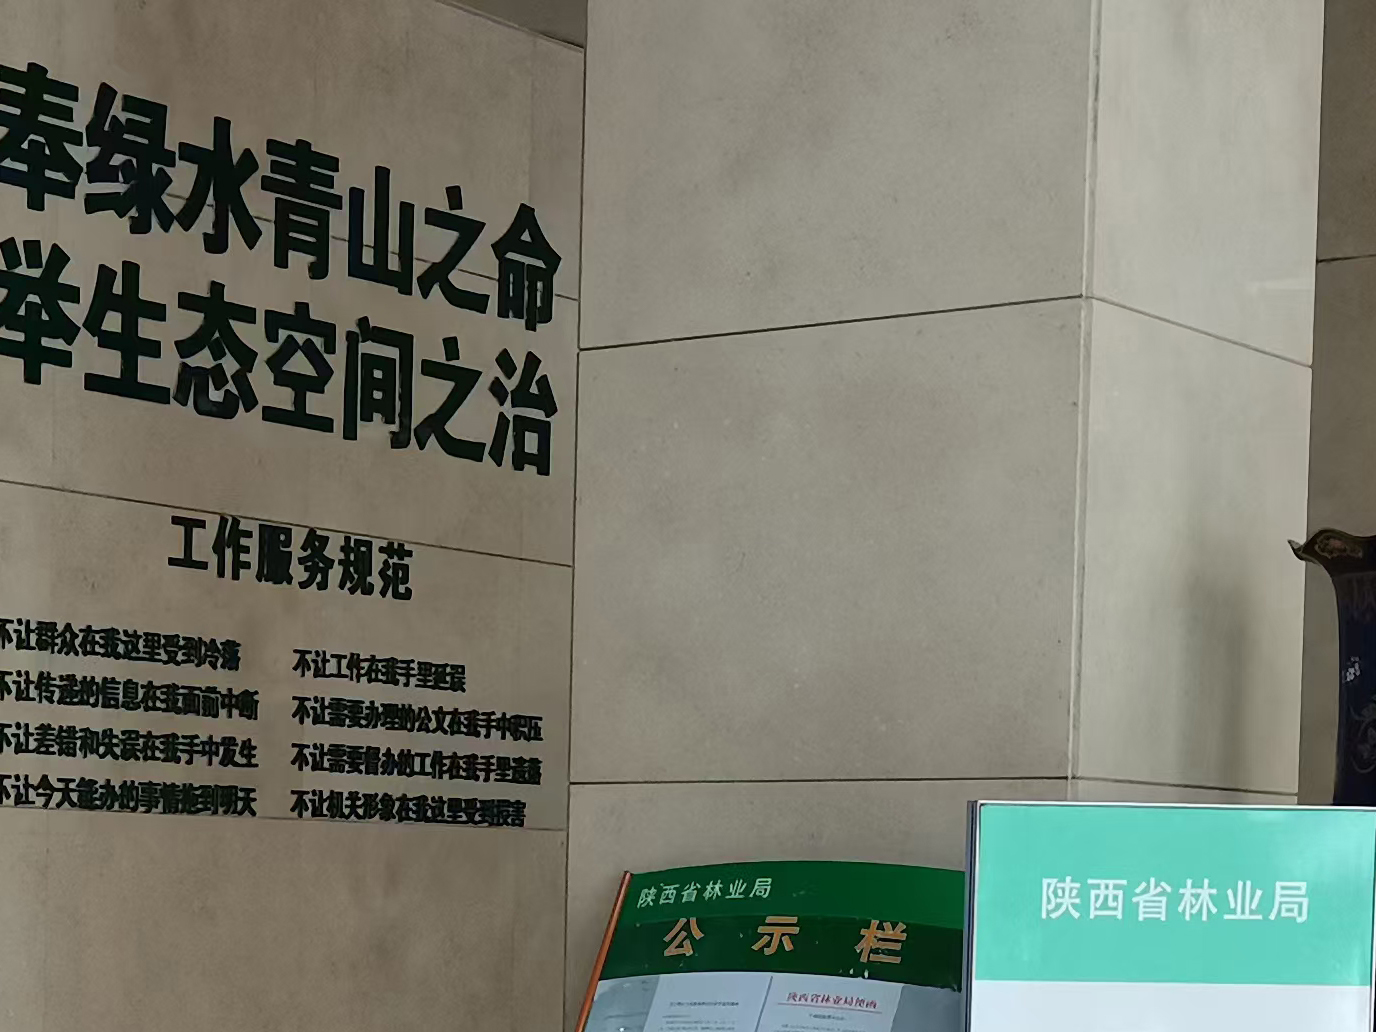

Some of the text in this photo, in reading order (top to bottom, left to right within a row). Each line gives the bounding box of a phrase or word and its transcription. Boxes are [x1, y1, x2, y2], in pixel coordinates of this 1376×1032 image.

[167, 515, 414, 600] 工作服务规范
[637, 877, 773, 909] 陕西省林业局
[1041, 876, 1310, 923] 陕西省林业局
[662, 916, 907, 964] 公示栏
